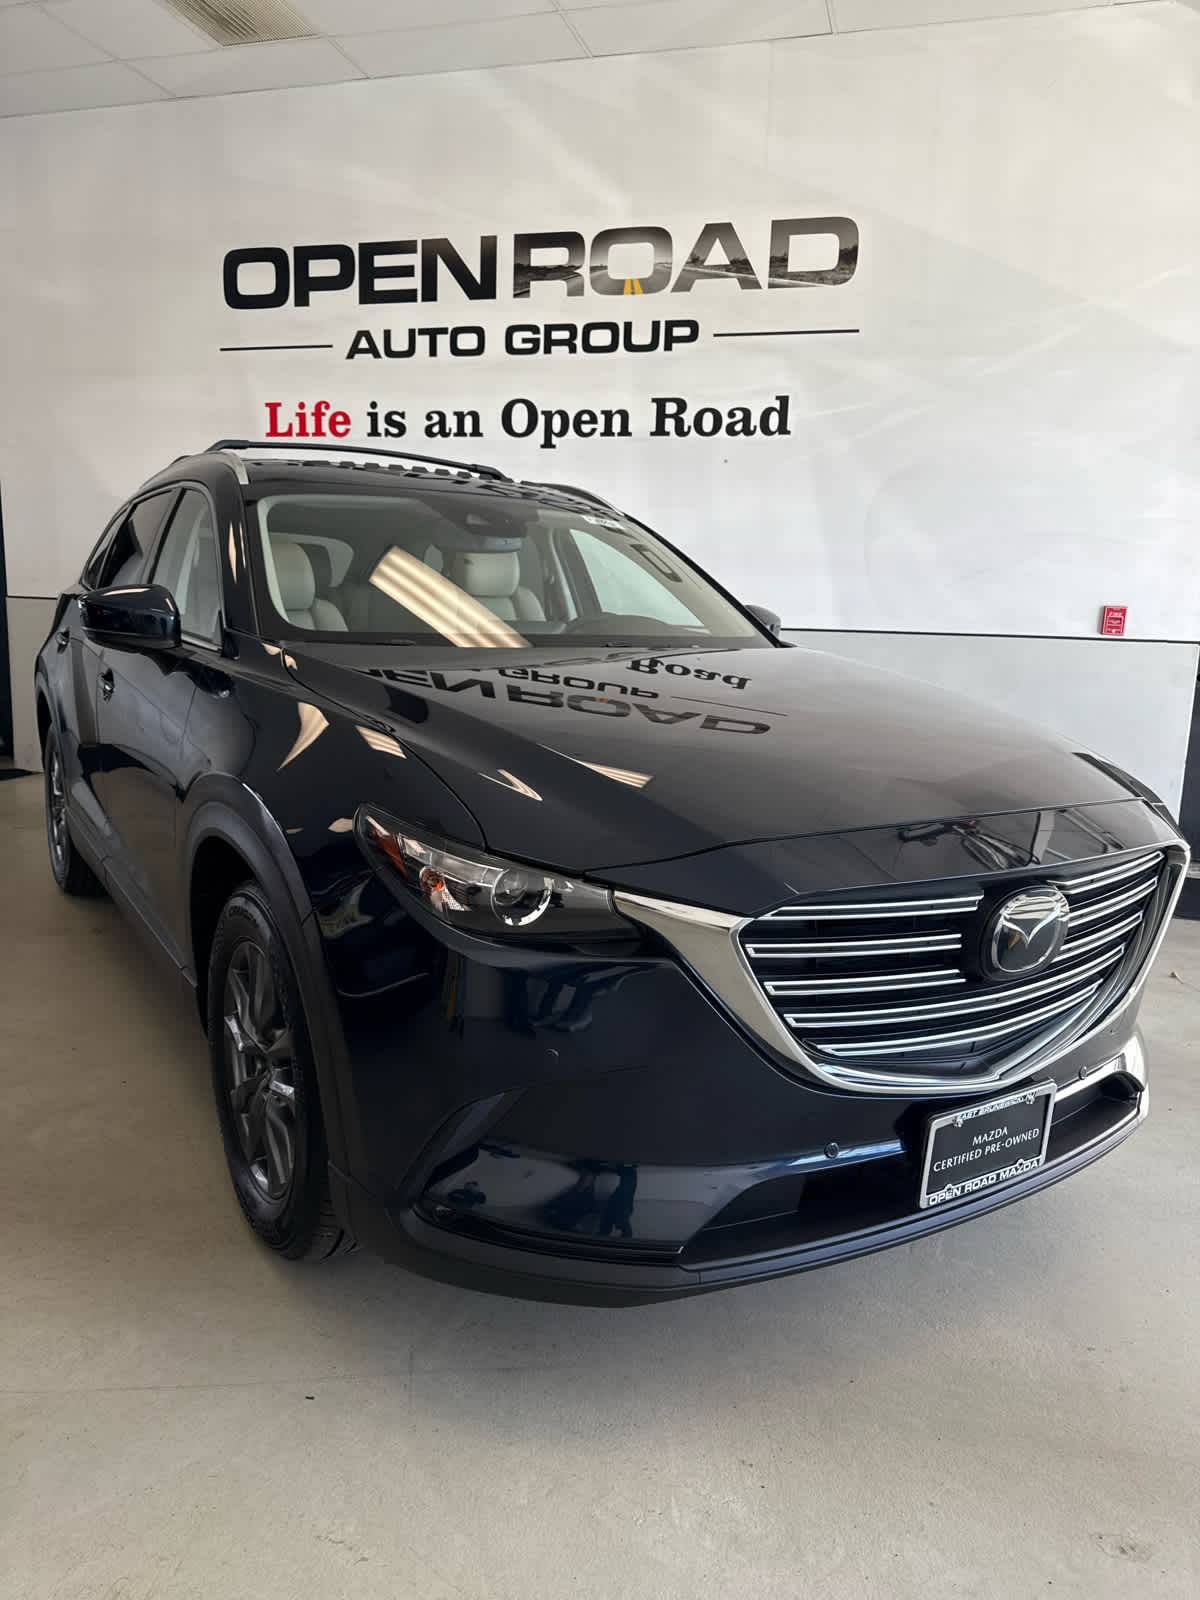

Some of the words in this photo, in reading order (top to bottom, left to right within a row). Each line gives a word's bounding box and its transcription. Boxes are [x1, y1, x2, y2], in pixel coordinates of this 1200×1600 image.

[222, 236, 498, 310] OPEN
[512, 217, 860, 299] ROAD
[345, 325, 487, 360] AUTO
[504, 320, 700, 356] GROUP
[265, 400, 352, 438] Life
[367, 400, 407, 438] is
[424, 410, 484, 439] an
[501, 398, 633, 450] Open
[649, 395, 792, 438] Road
[933, 1148, 982, 1172] CERTIFIED
[984, 1128, 1040, 1156] PRE-OWNED
[972, 1126, 1009, 1147] MAZDA
[928, 1187, 962, 1206] OPEN
[964, 1174, 997, 1193] ROAD
[999, 1160, 1039, 1181] MAZDA
